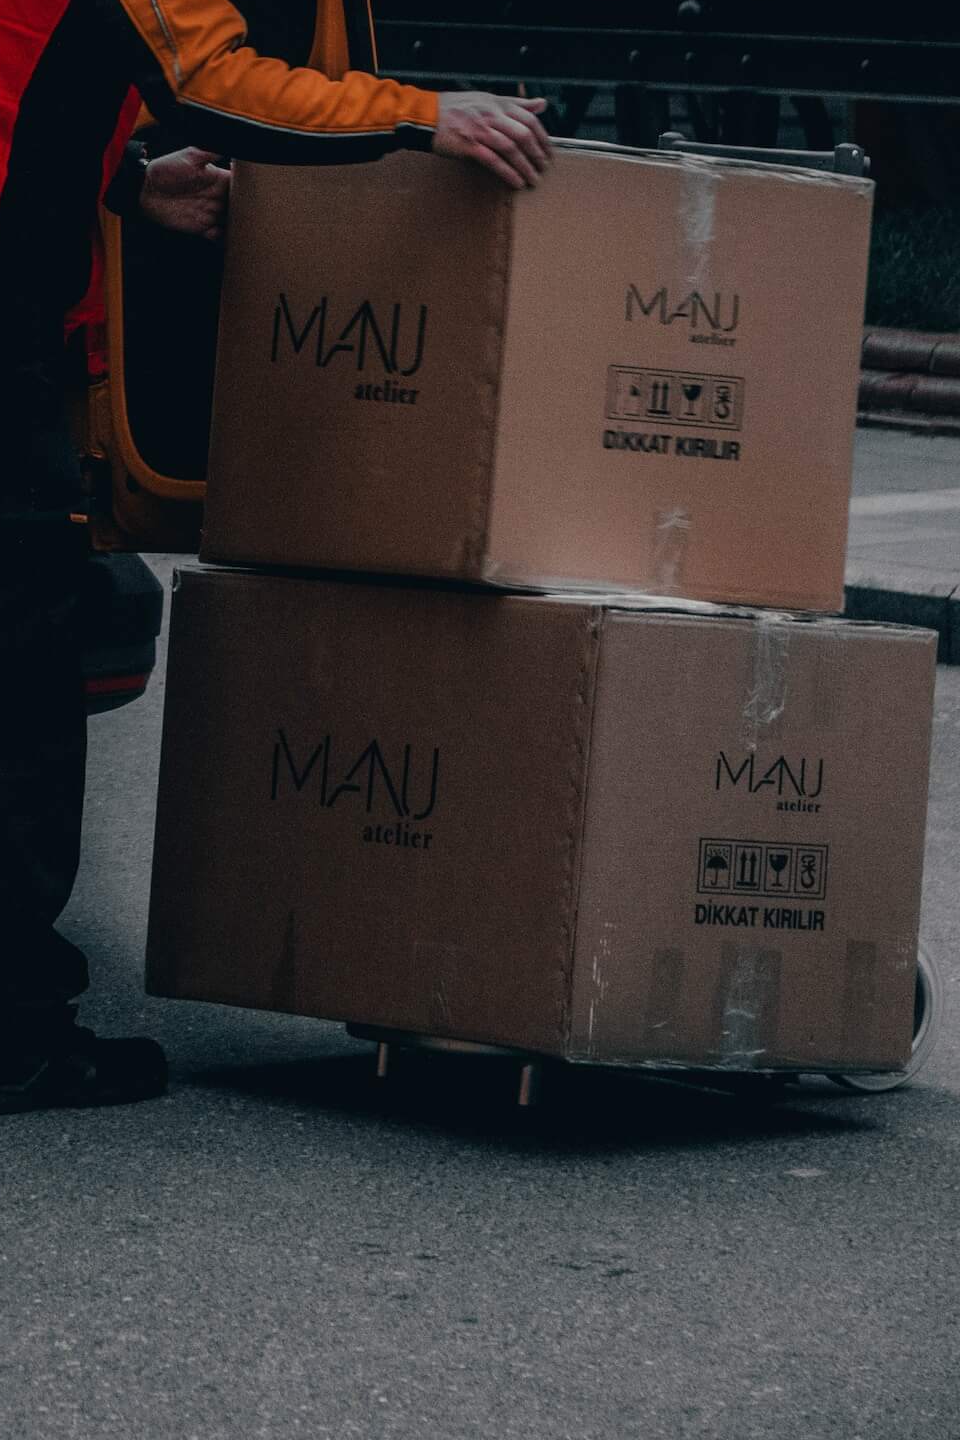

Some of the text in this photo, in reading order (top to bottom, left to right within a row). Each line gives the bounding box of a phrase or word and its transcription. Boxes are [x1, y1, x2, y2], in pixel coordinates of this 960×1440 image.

[625, 282, 740, 333] MANU
[271, 292, 429, 377] MANU
[354, 379, 421, 406] atelier
[271, 729, 439, 821] MANU
[715, 751, 824, 799] MANU
[776, 799, 822, 814] atelier
[362, 823, 433, 850] atelier
[695, 899, 826, 932] DİKKAT KIRILIR
